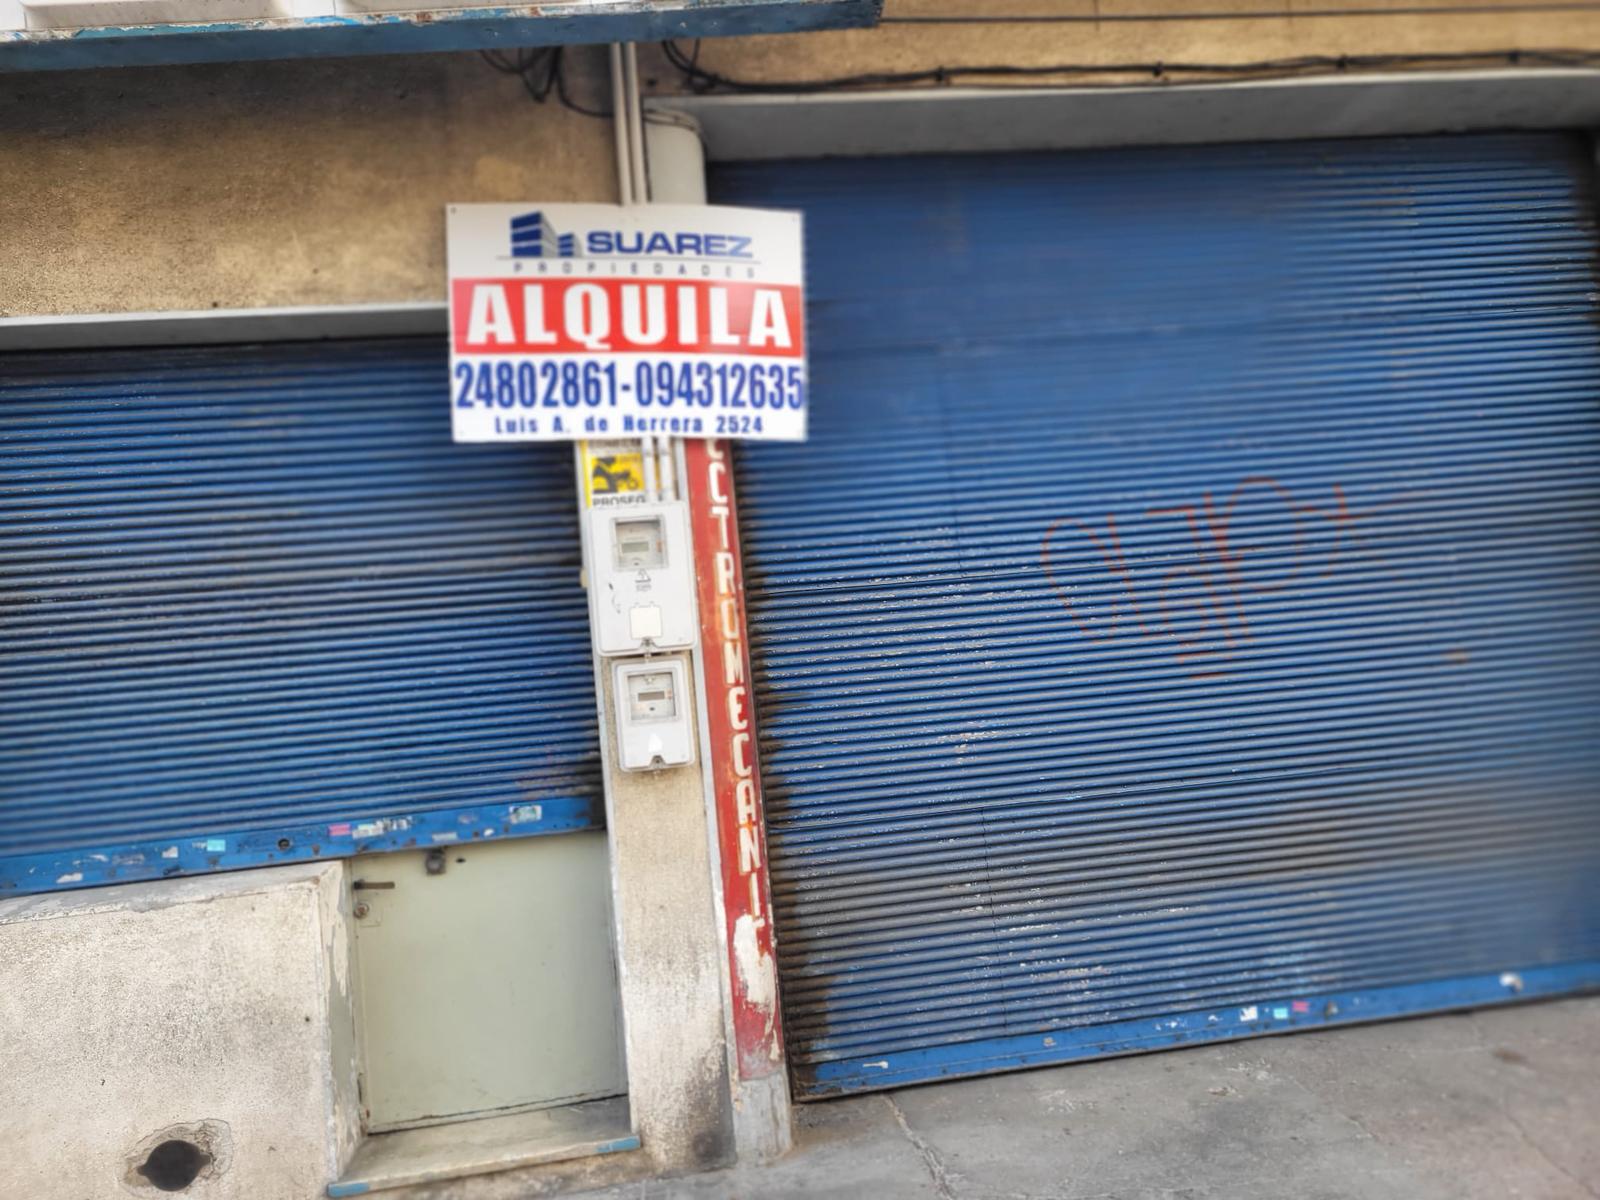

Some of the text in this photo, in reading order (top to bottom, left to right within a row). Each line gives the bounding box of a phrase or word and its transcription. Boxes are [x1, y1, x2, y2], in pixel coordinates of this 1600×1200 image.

[587, 231, 753, 258] SUAREZ
[513, 261, 755, 279] PROPIEDADES
[466, 283, 793, 350] ALQUILA
[455, 361, 804, 410] 24802861-094312635
[495, 417, 538, 434] Luis
[585, 416, 609, 432] de
[623, 415, 703, 433] Herrera
[716, 416, 763, 433] 2524
